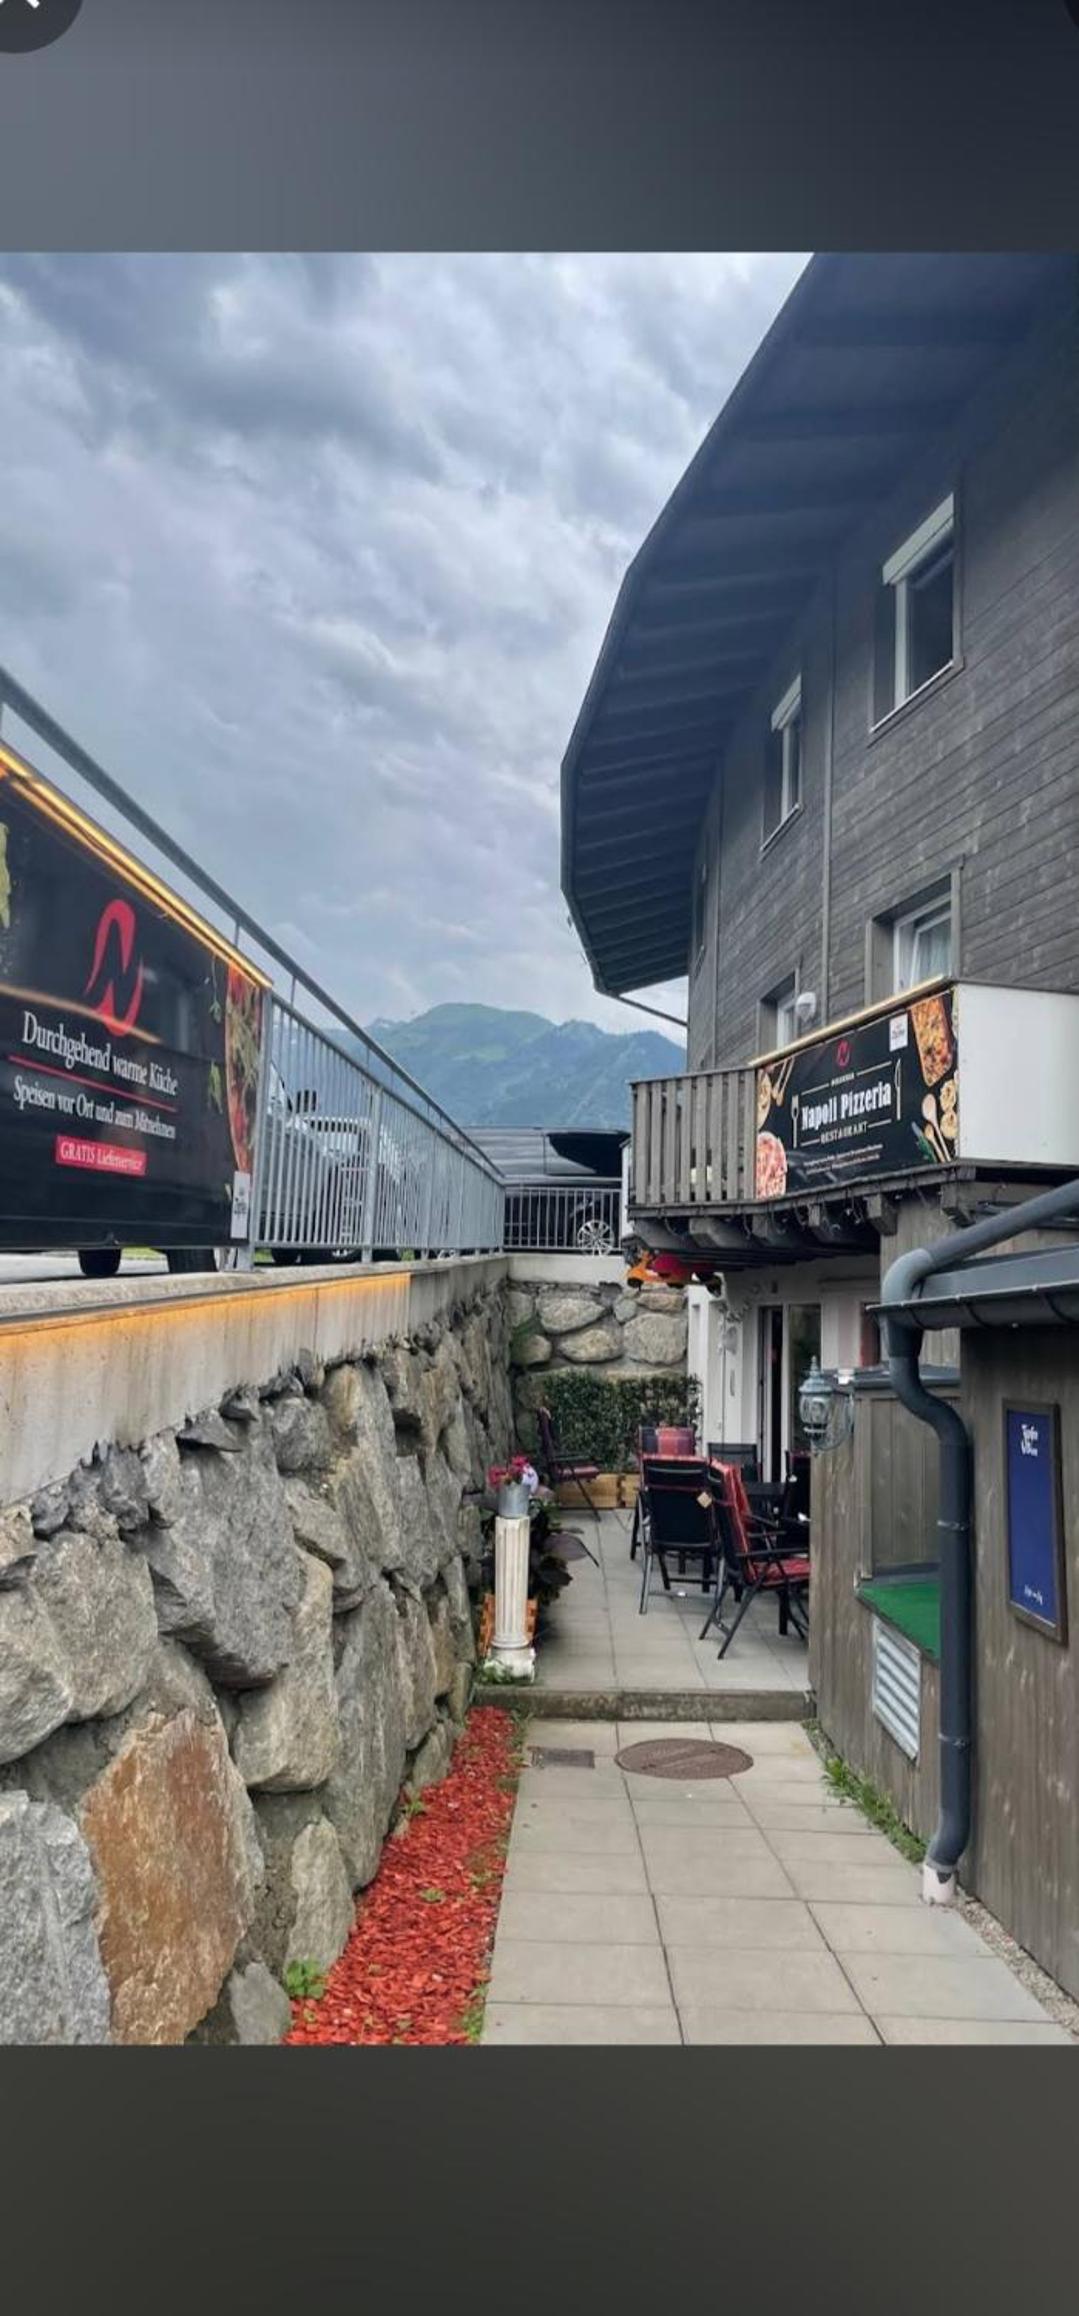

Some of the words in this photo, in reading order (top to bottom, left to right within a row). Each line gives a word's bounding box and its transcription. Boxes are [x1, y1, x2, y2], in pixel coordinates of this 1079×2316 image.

[22, 1010, 111, 1069] Durchgehend
[112, 1055, 148, 1086] warme
[149, 1062, 178, 1095] Küche
[13, 1075, 55, 1110] Speisen
[57, 1094, 74, 1114] vor
[76, 1093, 94, 1119] Ort
[95, 1101, 114, 1123] und
[115, 1112, 134, 1130] zum
[134, 1109, 176, 1139] Mitnehmen
[801, 1095, 838, 1131] Napoli
[840, 1081, 892, 1120] Pizzeria
[60, 1142, 95, 1165] GRATIS
[820, 1121, 868, 1144] RESTAURANT
